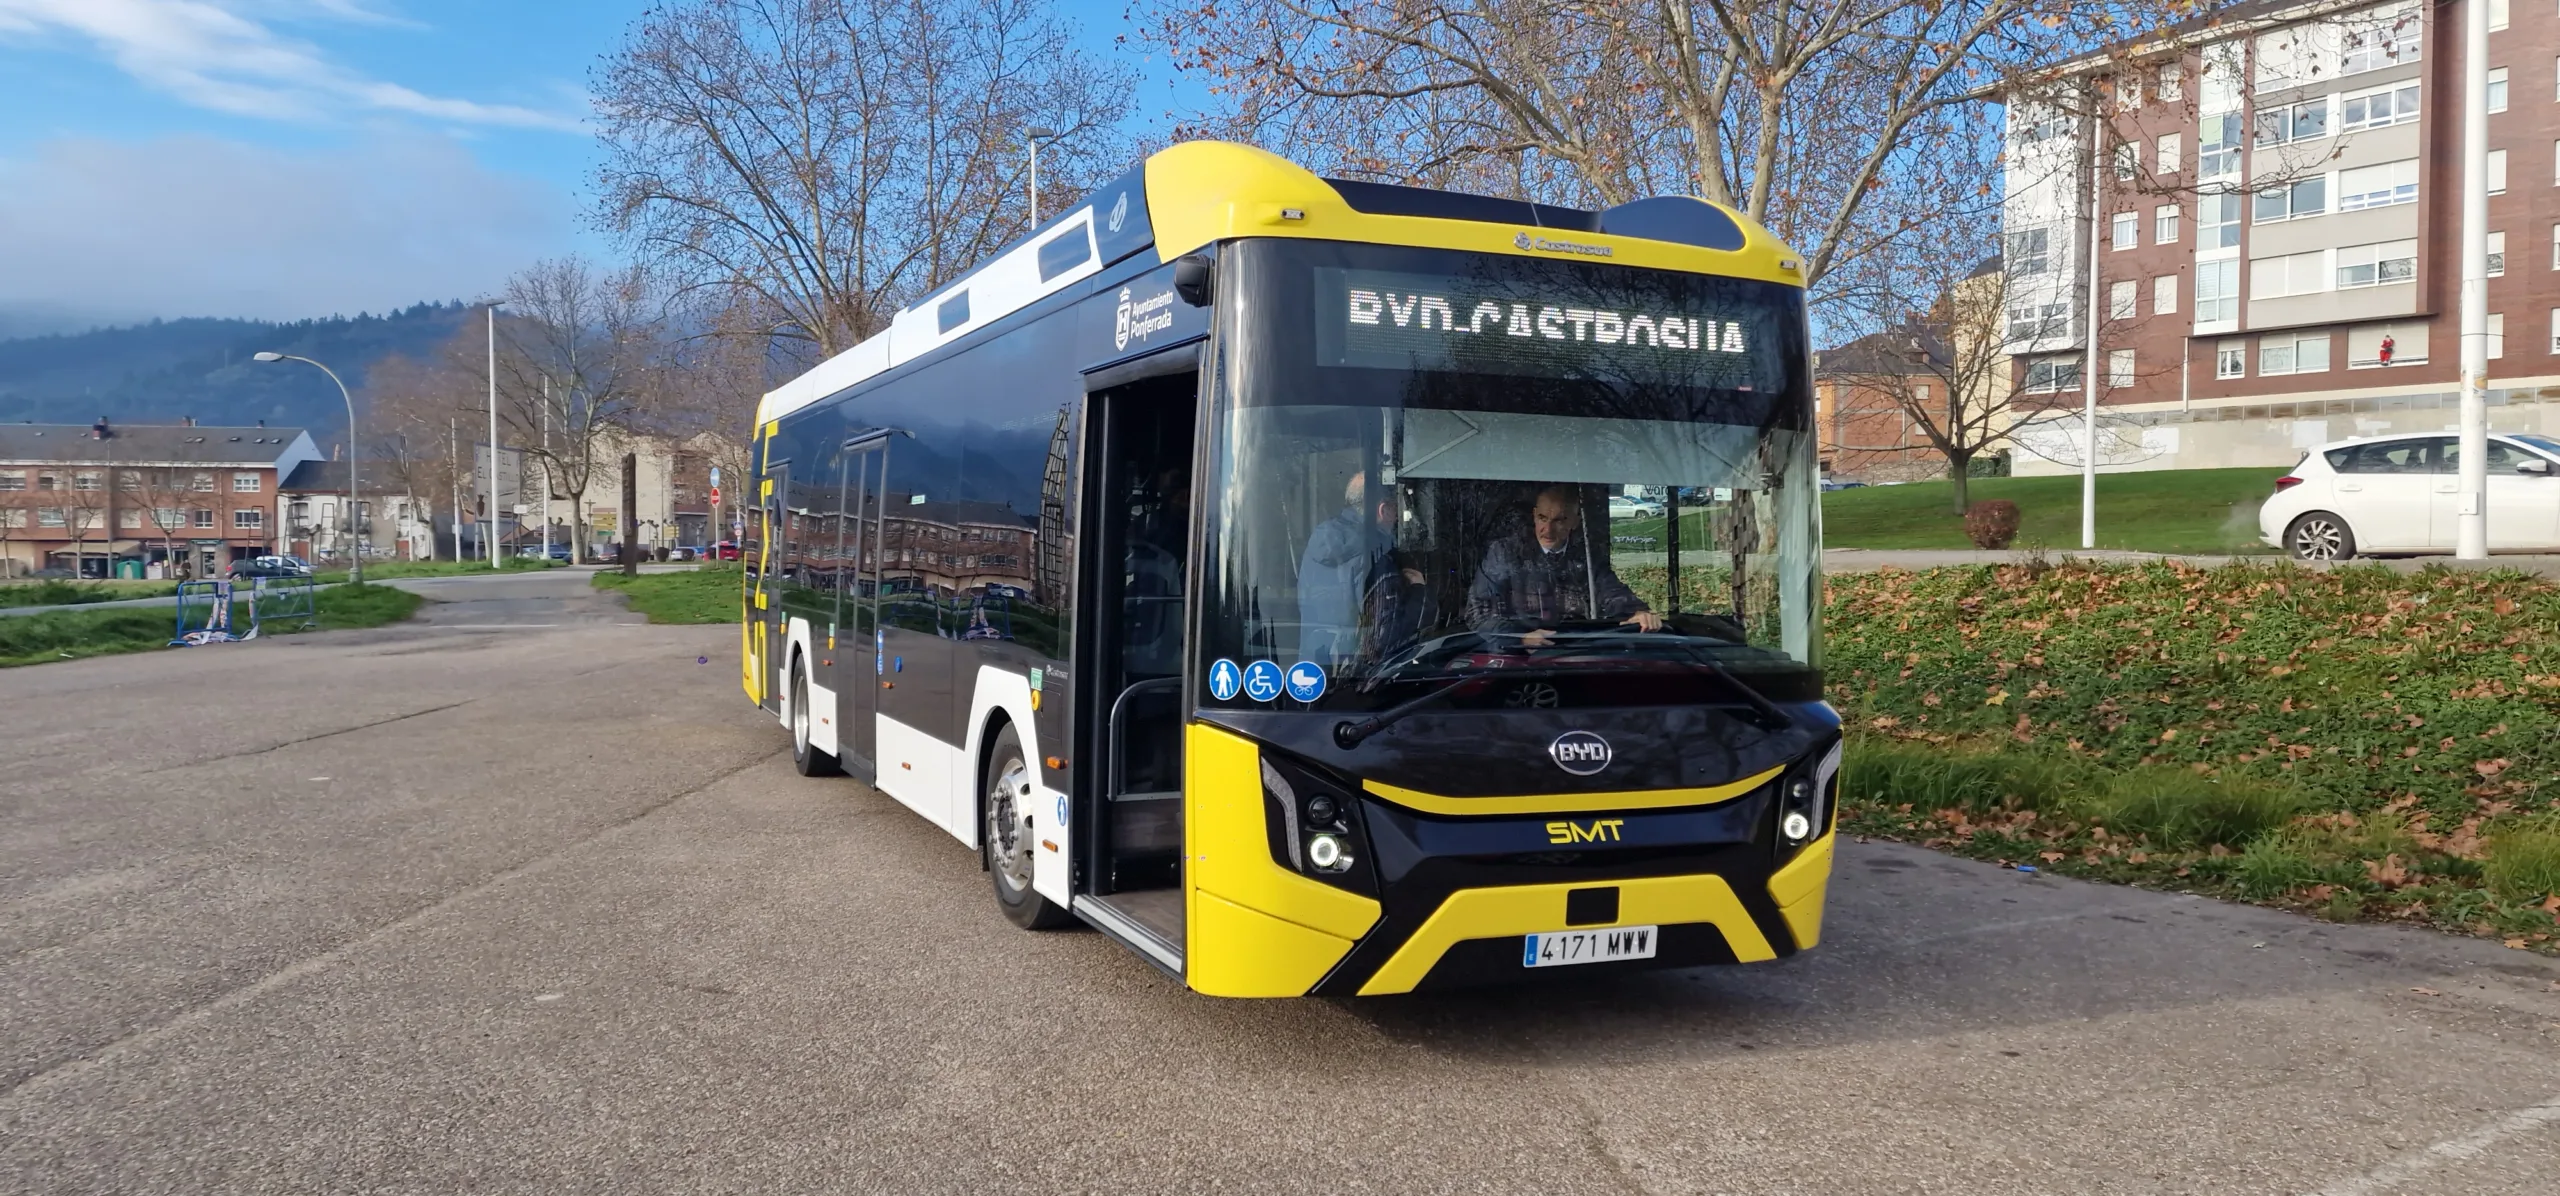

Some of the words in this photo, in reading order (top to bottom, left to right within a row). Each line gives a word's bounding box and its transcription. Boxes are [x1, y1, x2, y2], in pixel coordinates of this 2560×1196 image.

[1535, 237, 1613, 257] Castrosua
[1132, 290, 1173, 320] Ayuntamiento
[1130, 308, 1172, 342] Ponferrada
[485, 449, 512, 467] HTEL
[1558, 743, 1605, 761] BYD
[1546, 820, 1624, 844] SMT
[1541, 933, 1597, 961] 4171
[1607, 930, 1649, 957] MWW
